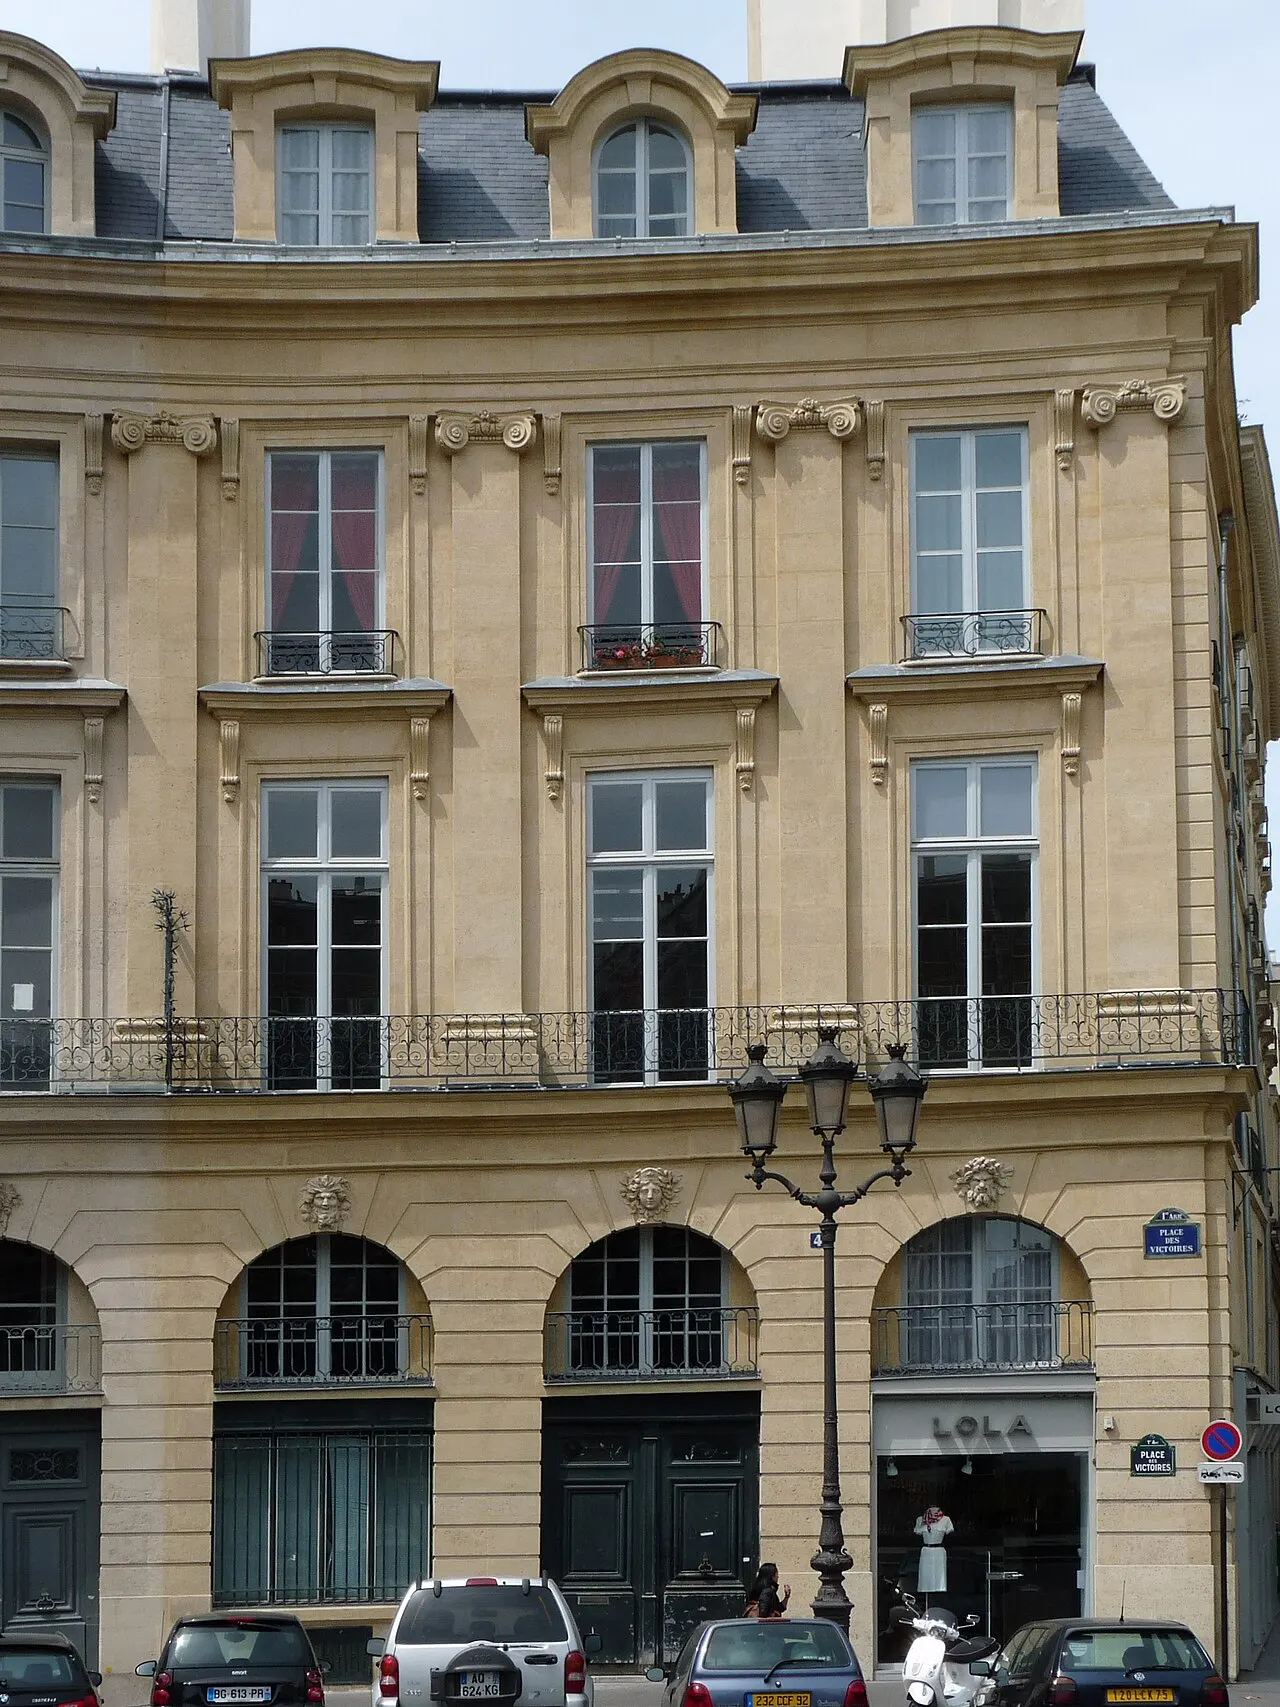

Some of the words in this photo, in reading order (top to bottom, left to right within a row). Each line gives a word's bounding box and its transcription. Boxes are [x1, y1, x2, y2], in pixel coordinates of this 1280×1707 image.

[813, 1234, 823, 1247] 4
[1150, 1245, 1194, 1253] VICTOIRES
[932, 1415, 1033, 1437] LOLA
[1140, 1450, 1166, 1459] PLACE
[1134, 1463, 1172, 1472] VICTOIRES
[756, 1695, 775, 1706] 232
[776, 1695, 795, 1706] CCF
[796, 1695, 809, 1706] 92
[1113, 1690, 1132, 1701] 120
[1156, 1690, 1168, 1700] 75
